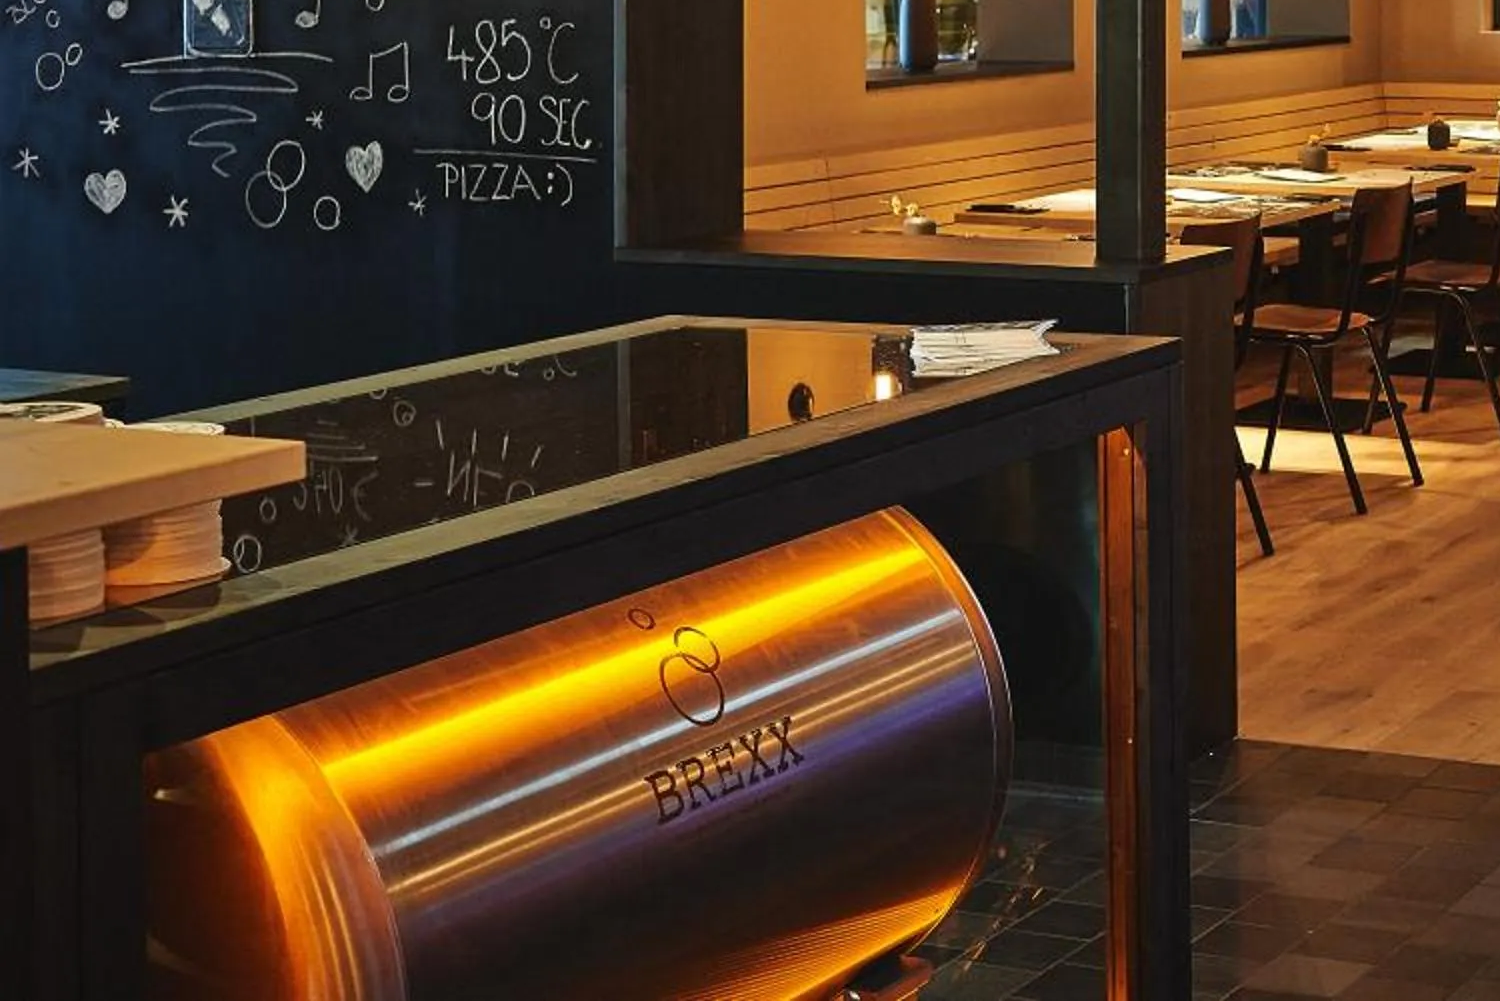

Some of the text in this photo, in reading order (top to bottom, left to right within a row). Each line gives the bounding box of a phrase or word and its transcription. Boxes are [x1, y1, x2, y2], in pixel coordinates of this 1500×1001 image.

[471, 92, 592, 149] 90 SEC
[644, 714, 805, 825] BREXX
